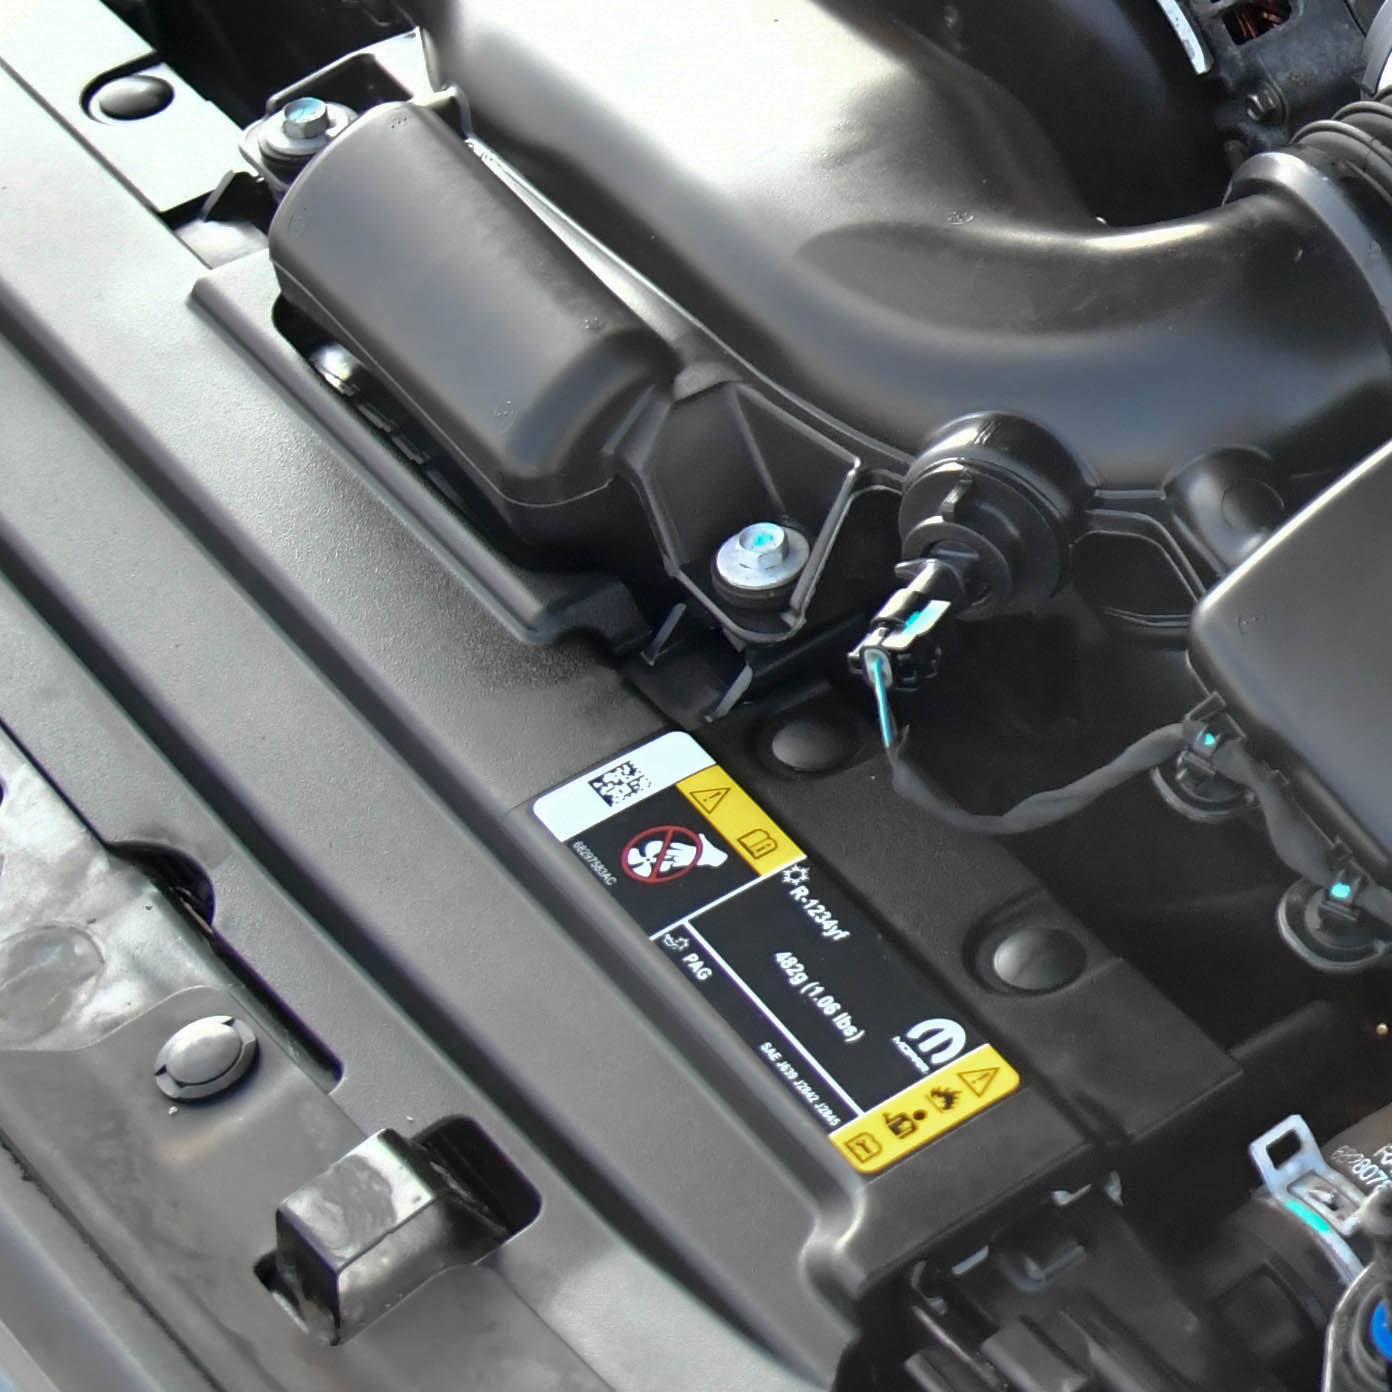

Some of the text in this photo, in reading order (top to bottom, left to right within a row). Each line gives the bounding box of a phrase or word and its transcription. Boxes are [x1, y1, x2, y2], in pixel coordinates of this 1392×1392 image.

[791, 884, 852, 943] R-1234yf
[682, 952, 713, 982] PAG
[772, 951, 866, 1044] 482g (1.06 lbs)
[760, 1041, 782, 1062] SAE
[776, 1060, 799, 1080] J639
